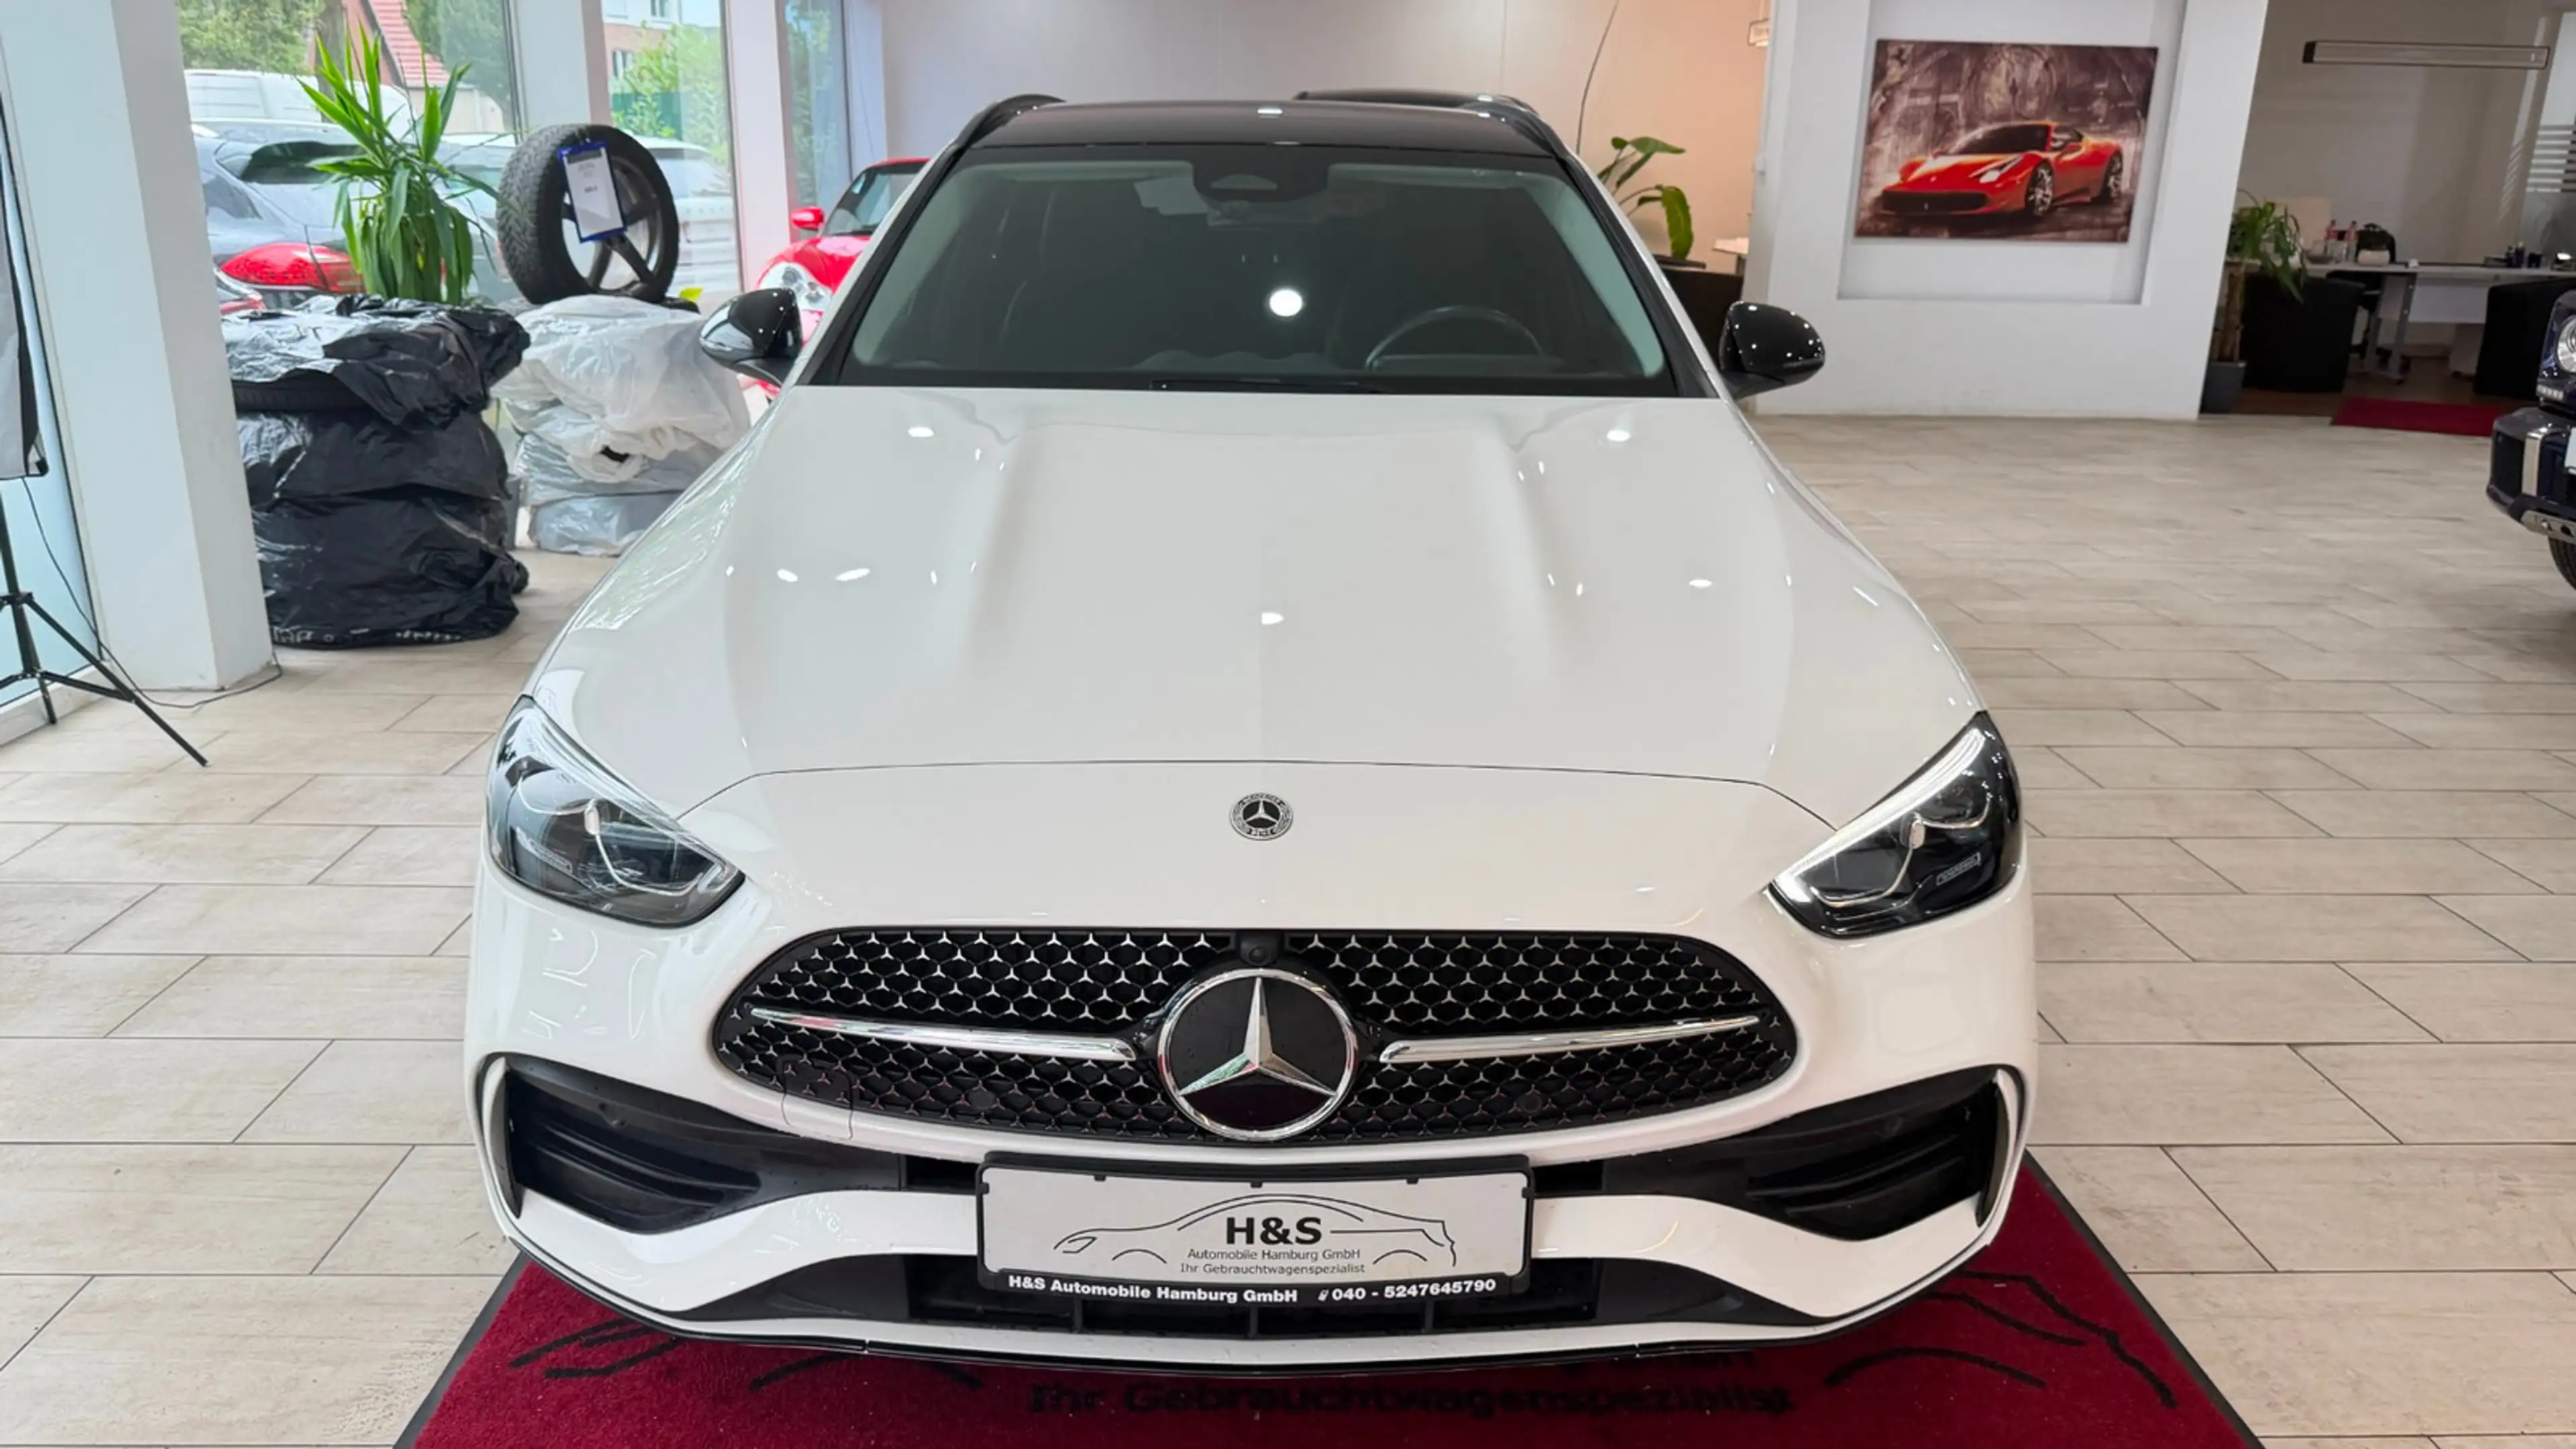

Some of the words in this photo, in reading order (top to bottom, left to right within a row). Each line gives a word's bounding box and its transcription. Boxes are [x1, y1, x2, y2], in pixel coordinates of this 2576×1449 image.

[1226, 1216, 1323, 1246] H&S
[1187, 1248, 1258, 1260] Automobile
[1261, 1249, 1318, 1262] Hamburg
[1322, 1249, 1360, 1260] GmbH
[1181, 1263, 1198, 1273] Ihr
[1202, 1263, 1366, 1276] Gebrauchtwagenspezialist
[1008, 1275, 1046, 1291] H&S
[1051, 1279, 1152, 1299] Automobile
[1156, 1286, 1238, 1303] Hamburg
[1242, 1289, 1298, 1303] GmbH
[1331, 1287, 1366, 1301] 040
[1383, 1278, 1497, 1299] 5247645790
